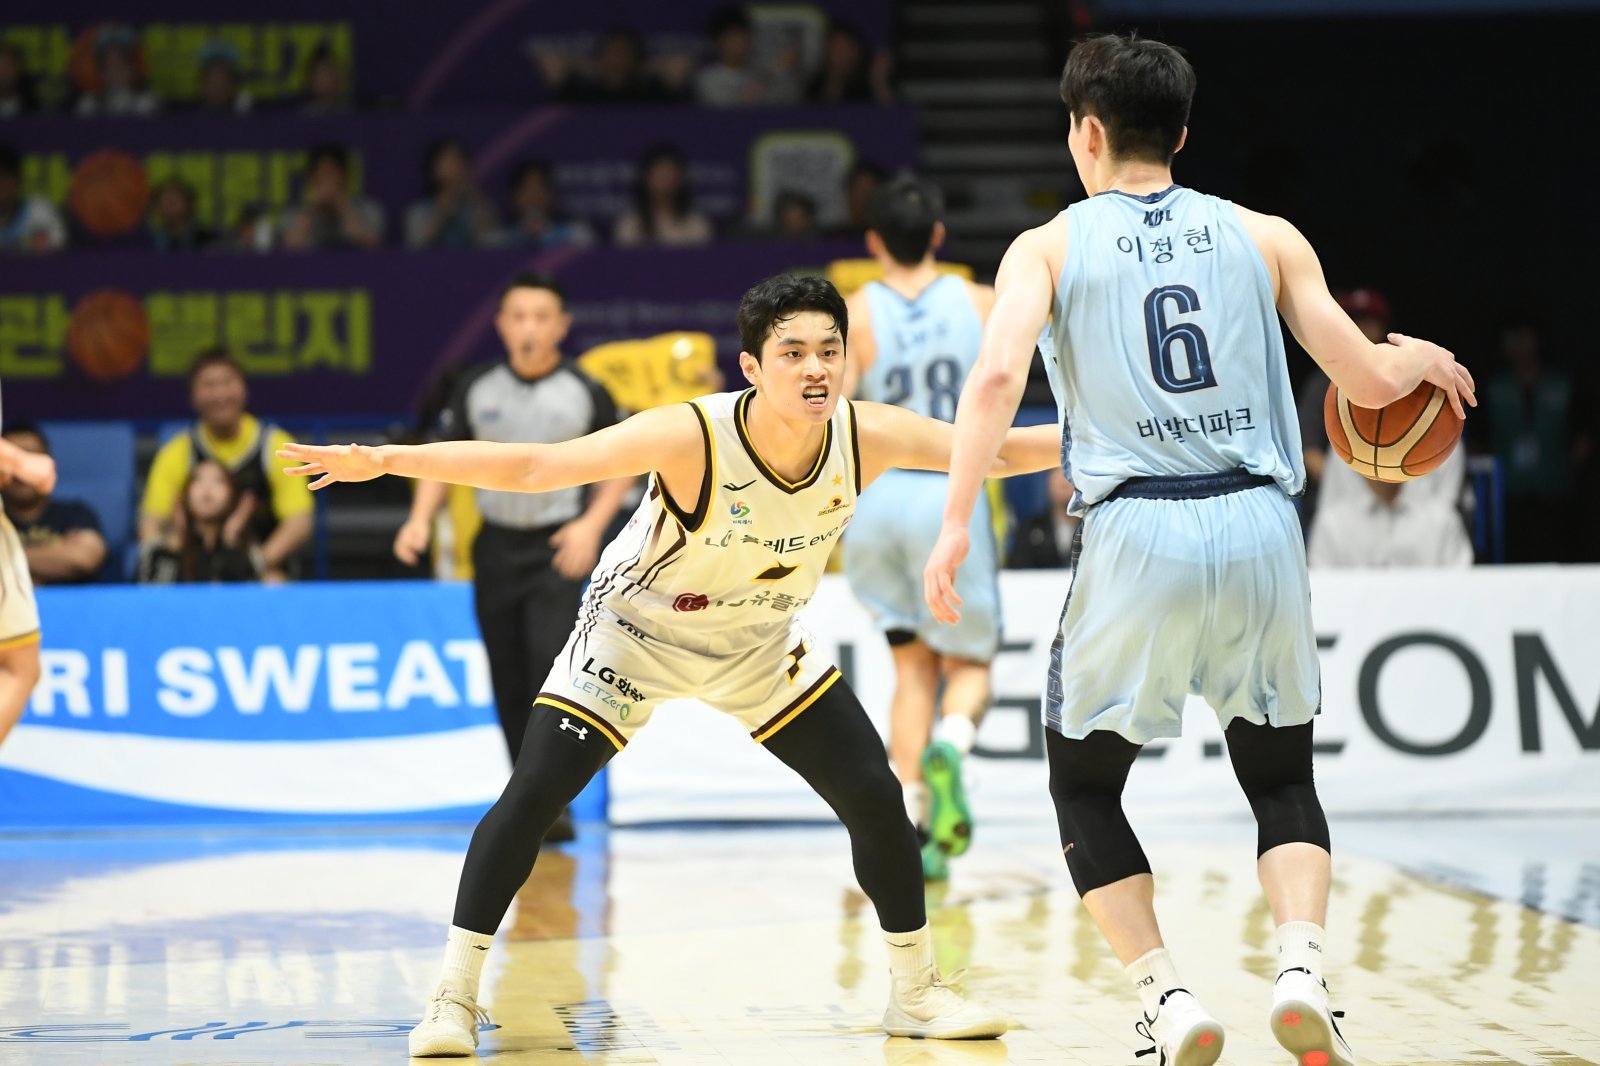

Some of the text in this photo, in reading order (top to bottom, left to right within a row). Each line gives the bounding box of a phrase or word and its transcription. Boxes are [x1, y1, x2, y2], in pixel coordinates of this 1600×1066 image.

[1116, 224, 1214, 264] 이정현
[1143, 284, 1219, 394] 6
[884, 354, 962, 425] 28
[1136, 407, 1256, 444] 비발디파크
[155, 638, 494, 718] SWEAT
